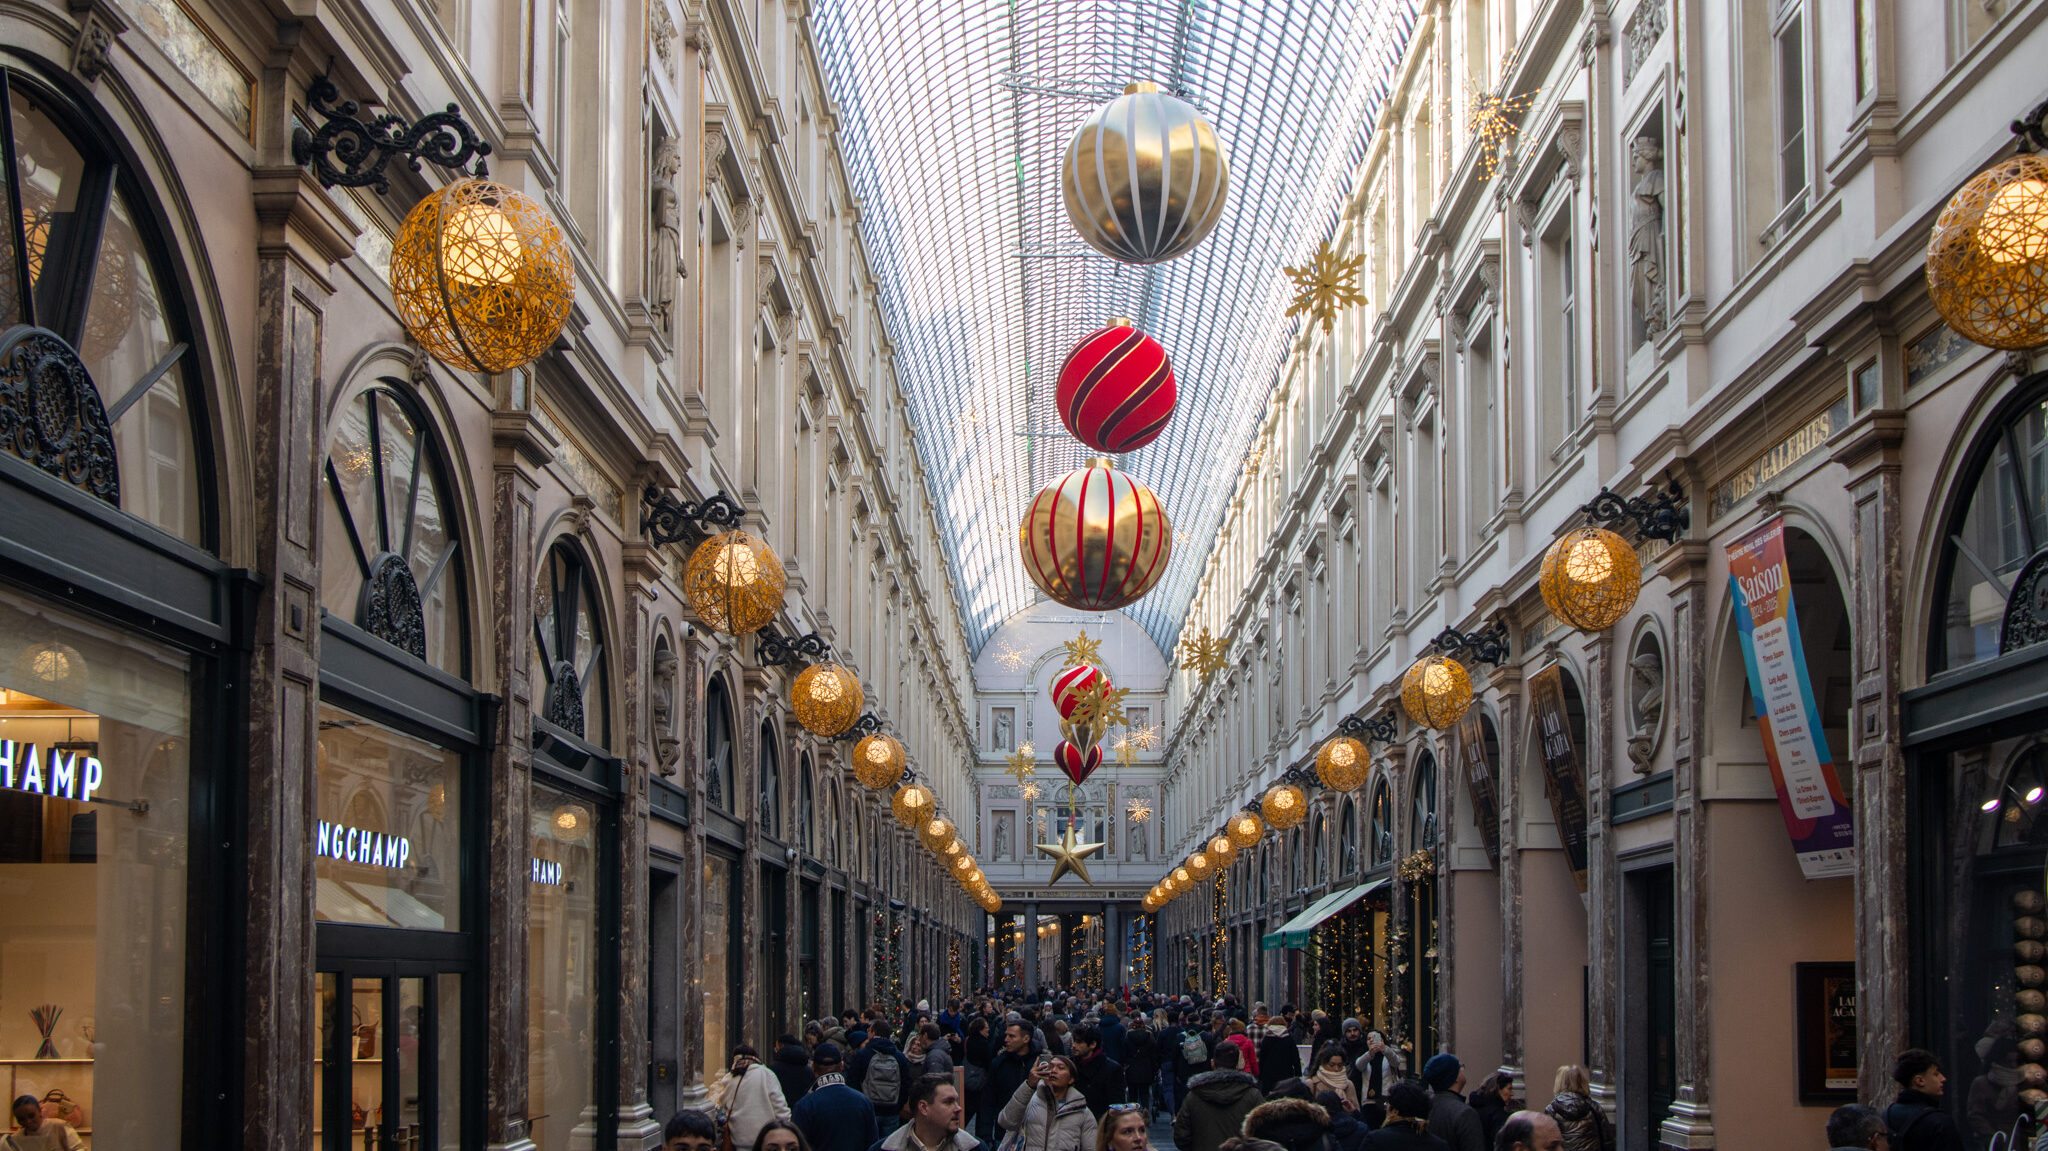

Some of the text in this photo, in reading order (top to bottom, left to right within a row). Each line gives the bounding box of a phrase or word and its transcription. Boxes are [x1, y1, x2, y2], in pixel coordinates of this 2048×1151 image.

[1732, 411, 1830, 503] DES GALERIES
[1738, 564, 1784, 606] Saison
[317, 819, 410, 869] NGCHAMP
